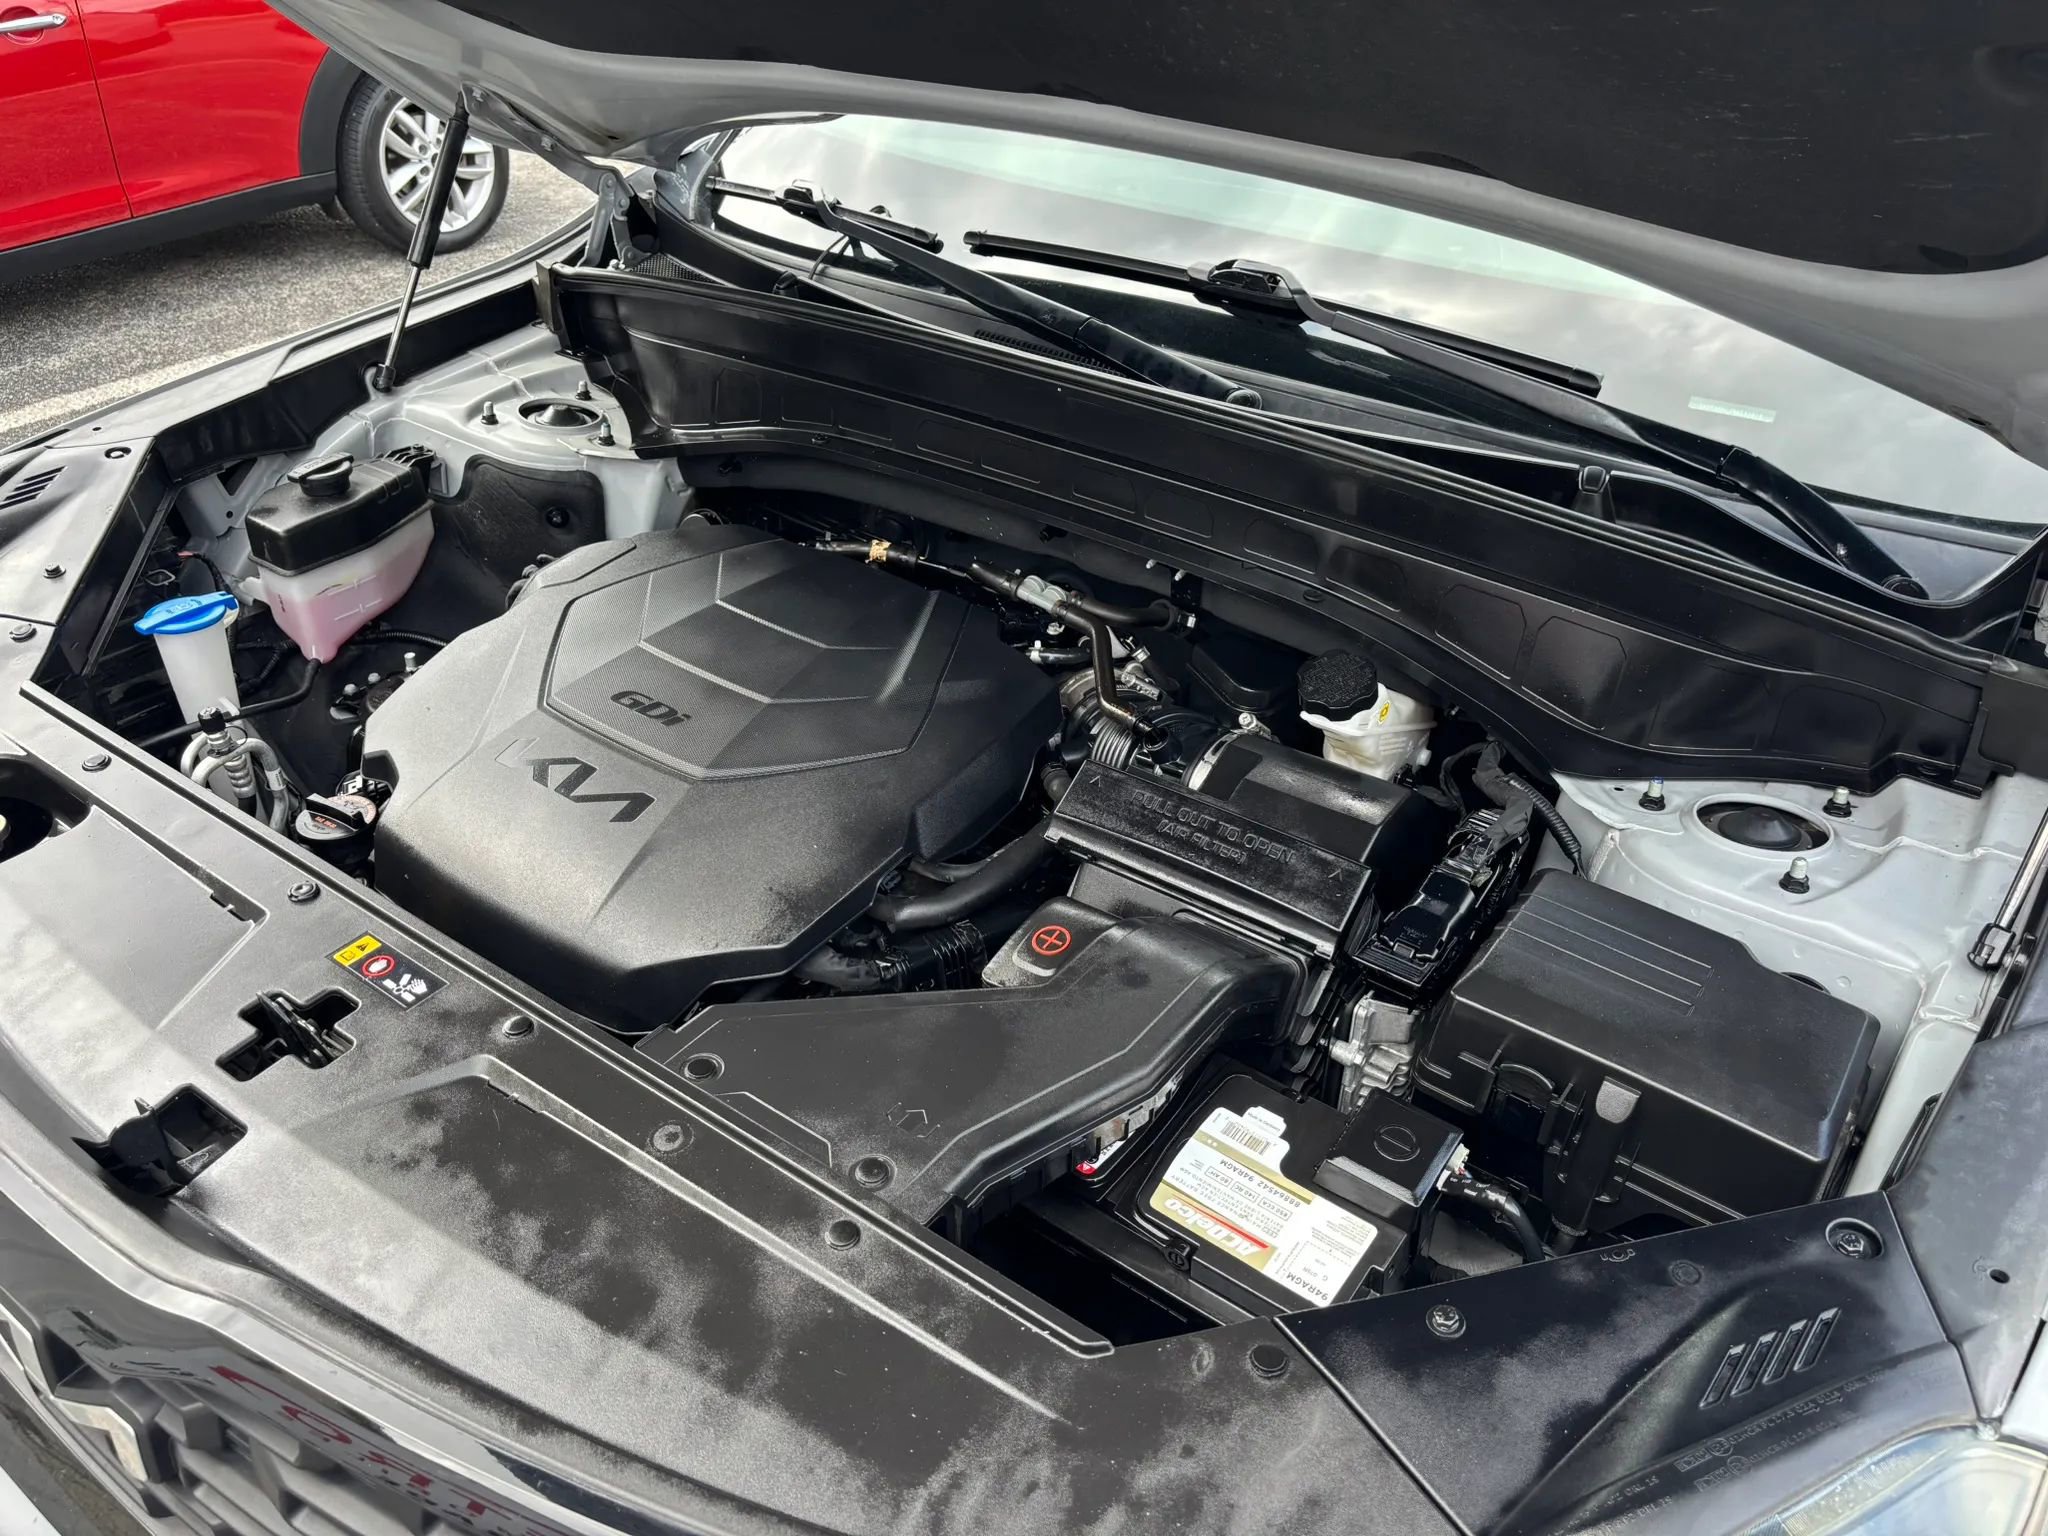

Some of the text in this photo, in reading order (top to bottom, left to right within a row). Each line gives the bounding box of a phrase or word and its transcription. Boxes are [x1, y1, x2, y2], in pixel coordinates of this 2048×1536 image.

[611, 690, 691, 726] GDi
[1131, 790, 1295, 865] PULL OUT TO OPEN
[1192, 832, 1248, 865] FILTER)
[1220, 1159, 1255, 1182] 94RAGM
[1258, 1180, 1301, 1208] 88864542
[1165, 1197, 1260, 1257] ACDelco
[1286, 1272, 1329, 1301] 94RAGM
